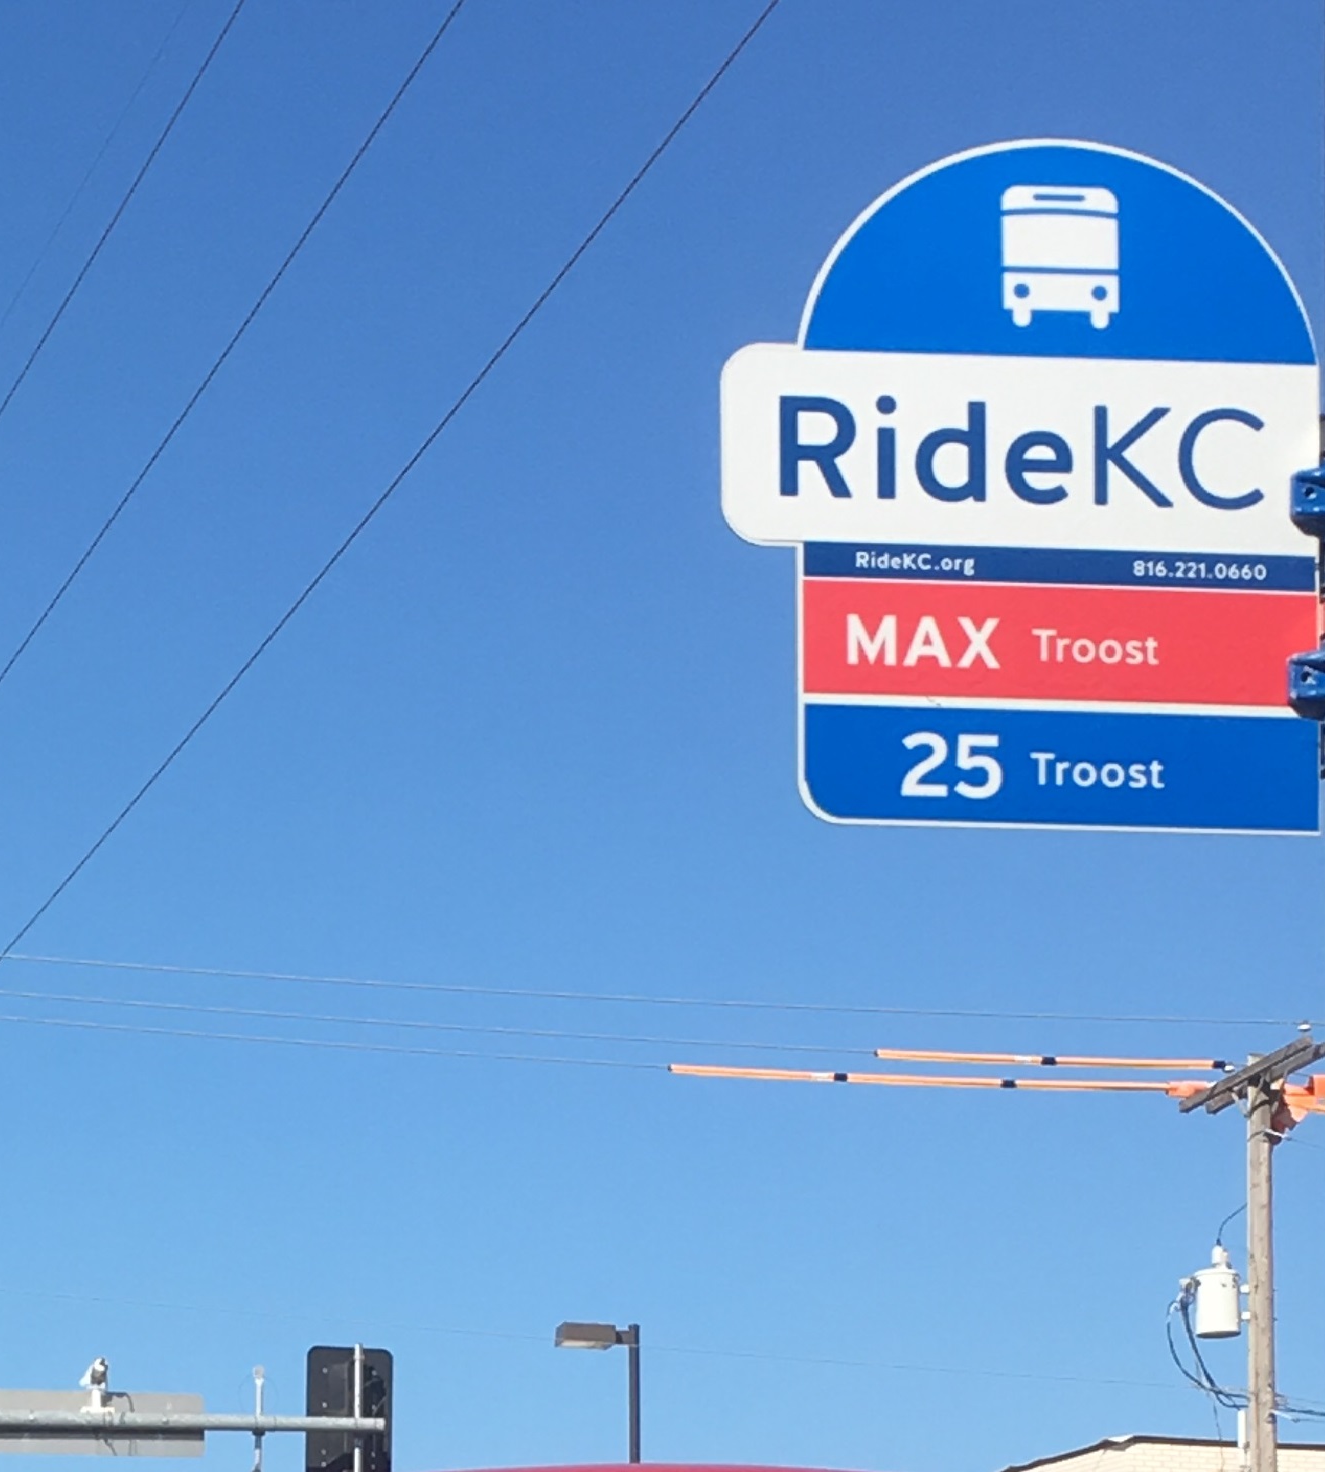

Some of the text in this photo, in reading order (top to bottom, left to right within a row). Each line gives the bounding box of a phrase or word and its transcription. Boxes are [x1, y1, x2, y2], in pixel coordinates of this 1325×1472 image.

[777, 394, 1266, 511] RideKC
[855, 550, 1268, 582] RideKC.org 816.221.0660
[845, 612, 1160, 670] MAX Troost
[900, 731, 1166, 800] 25 Troost
